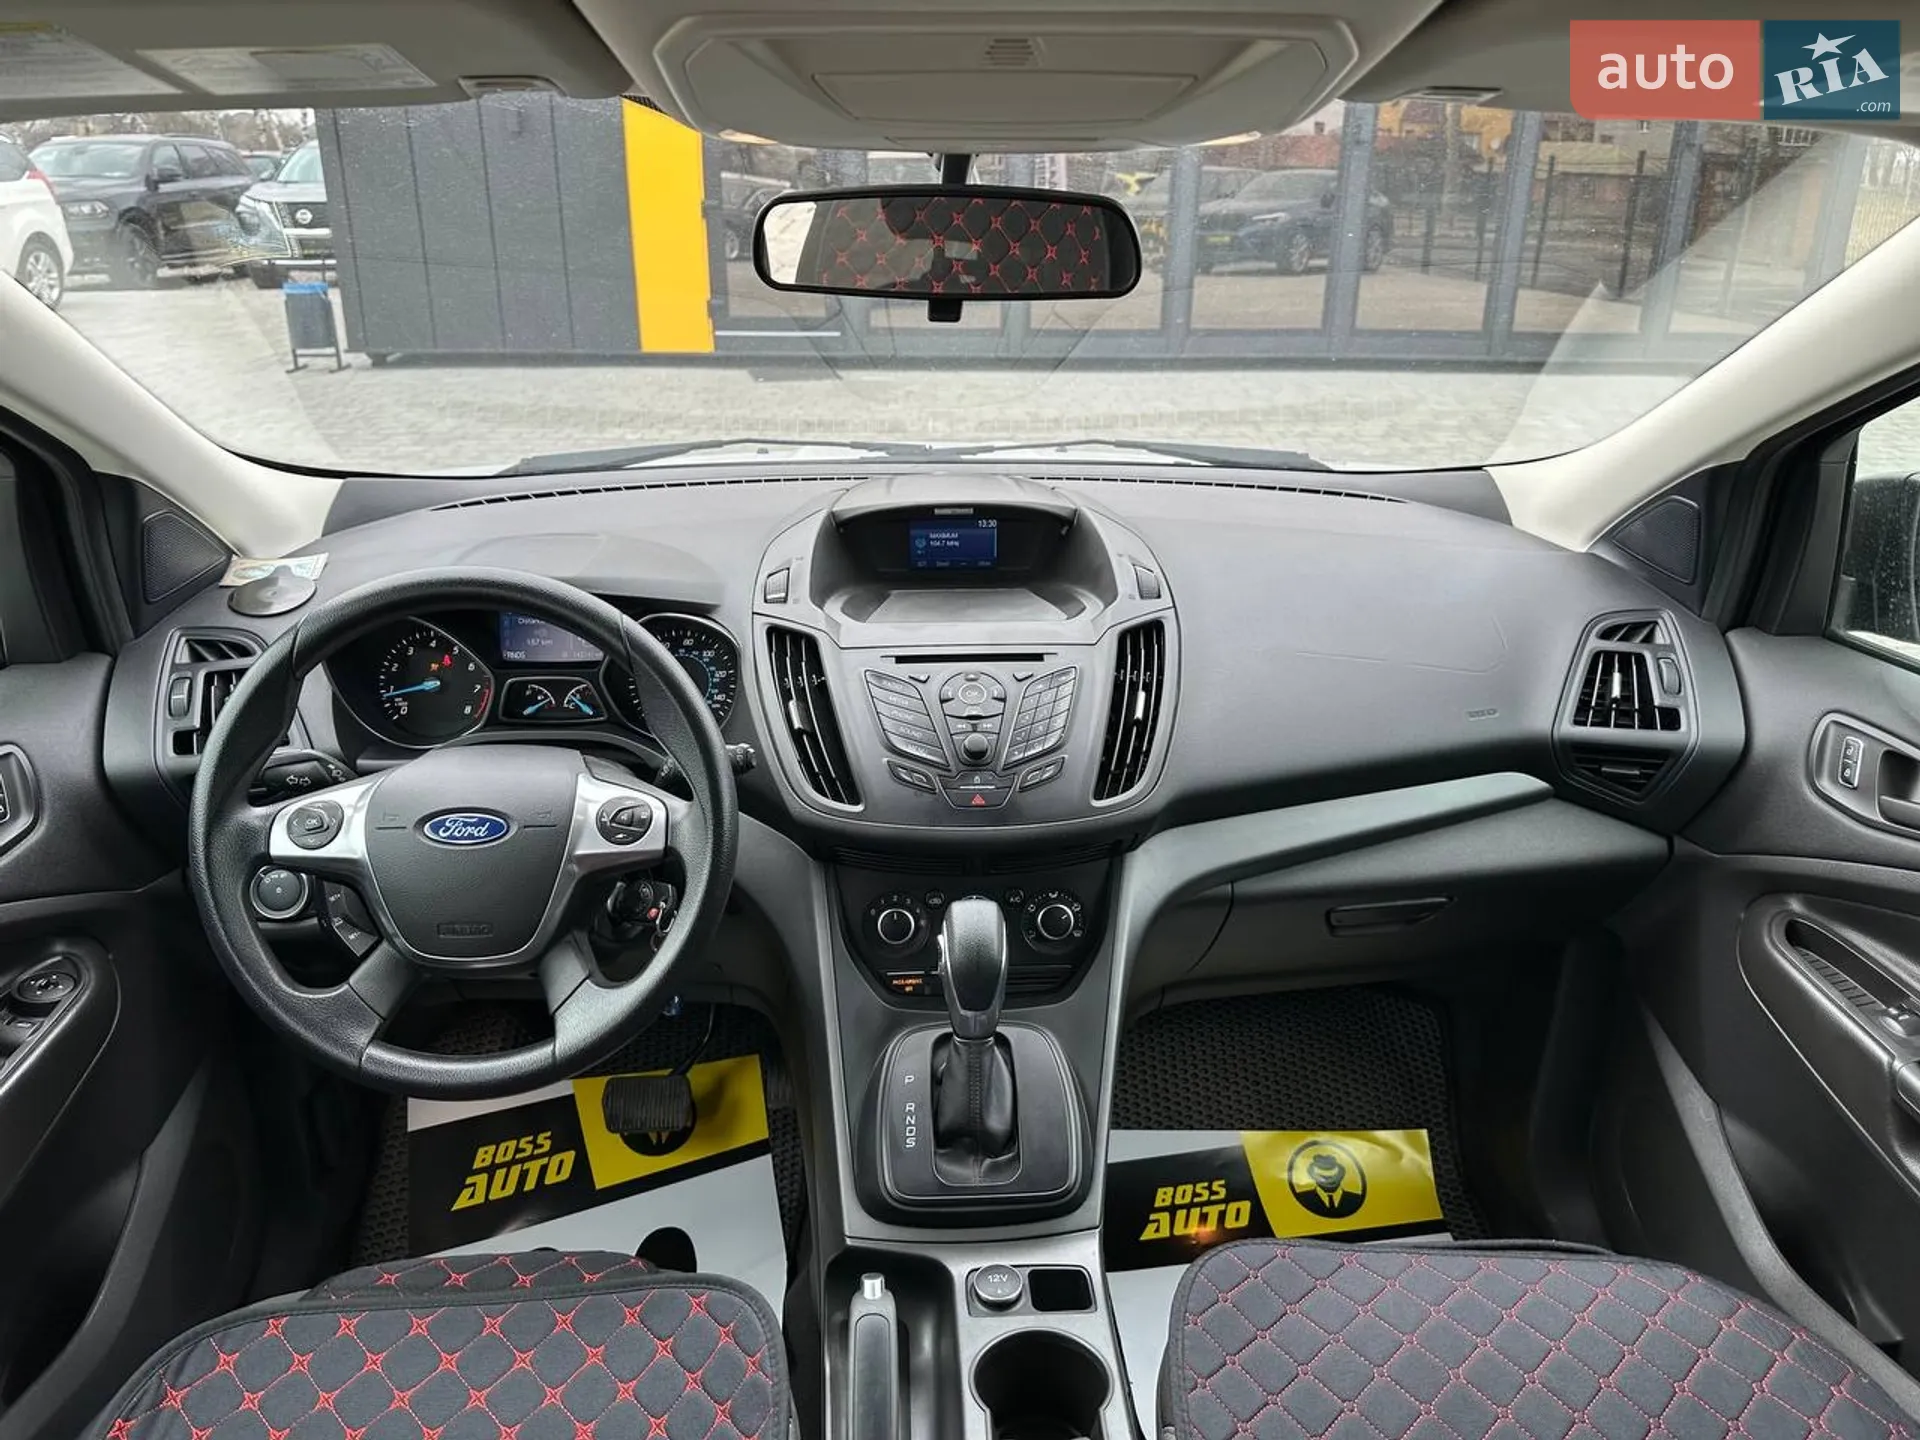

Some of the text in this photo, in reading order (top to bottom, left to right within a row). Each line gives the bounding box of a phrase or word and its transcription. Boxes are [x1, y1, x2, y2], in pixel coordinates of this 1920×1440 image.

[977, 519, 997, 528] 13:30
[429, 640, 437, 648] 4
[406, 646, 414, 656] 3
[453, 646, 460, 655] 5
[391, 663, 399, 672] 2
[468, 662, 476, 671] 6
[714, 670, 728, 678] 120
[473, 684, 481, 693] 7
[713, 693, 726, 702] 140
[400, 706, 408, 715] 0
[463, 705, 472, 715] 8
[306, 818, 319, 826] OK
[438, 817, 490, 837] Ford
[904, 1075, 914, 1085] P
[905, 1103, 916, 1112] R
[905, 1115, 916, 1125] N
[905, 1127, 916, 1137] D
[905, 1138, 916, 1148] S
[472, 1131, 552, 1170] BOSS
[450, 1150, 576, 1212] AUTO
[1154, 1179, 1227, 1208] BOSS
[1139, 1200, 1252, 1241] AUTO
[987, 1274, 1008, 1283] 12V
